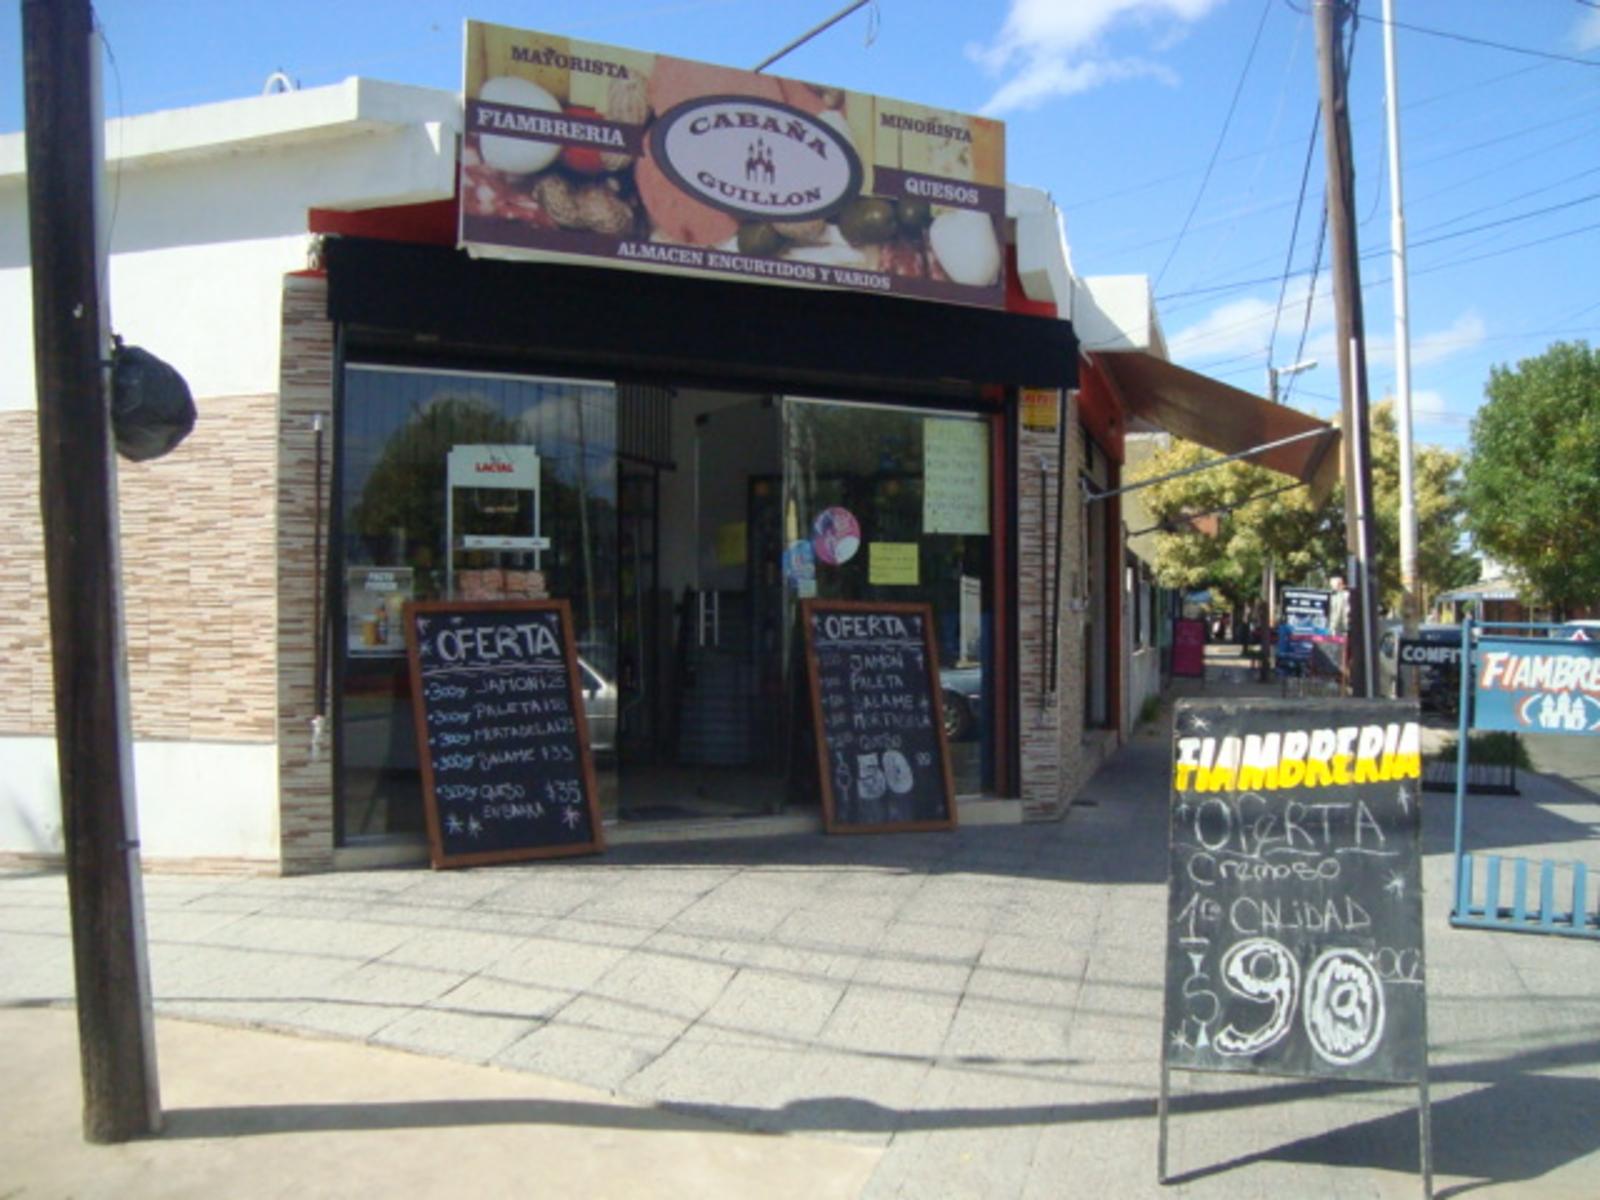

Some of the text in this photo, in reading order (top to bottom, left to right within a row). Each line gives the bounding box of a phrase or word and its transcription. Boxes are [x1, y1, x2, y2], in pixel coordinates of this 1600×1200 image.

[510, 45, 630, 81] MAYORISTA
[476, 106, 626, 147] FIAMBRERIA
[689, 112, 828, 160] CABAÑA
[880, 112, 973, 143] MINORISTA
[697, 171, 822, 207] GUILLON
[905, 176, 979, 205] QUESOS
[617, 241, 891, 291] ALMACEN ENCURTIDOS Y VARIOS
[436, 623, 561, 661] OFERTA
[825, 614, 909, 640] OFERTA
[1175, 722, 1421, 792] FIAMBRERIA
